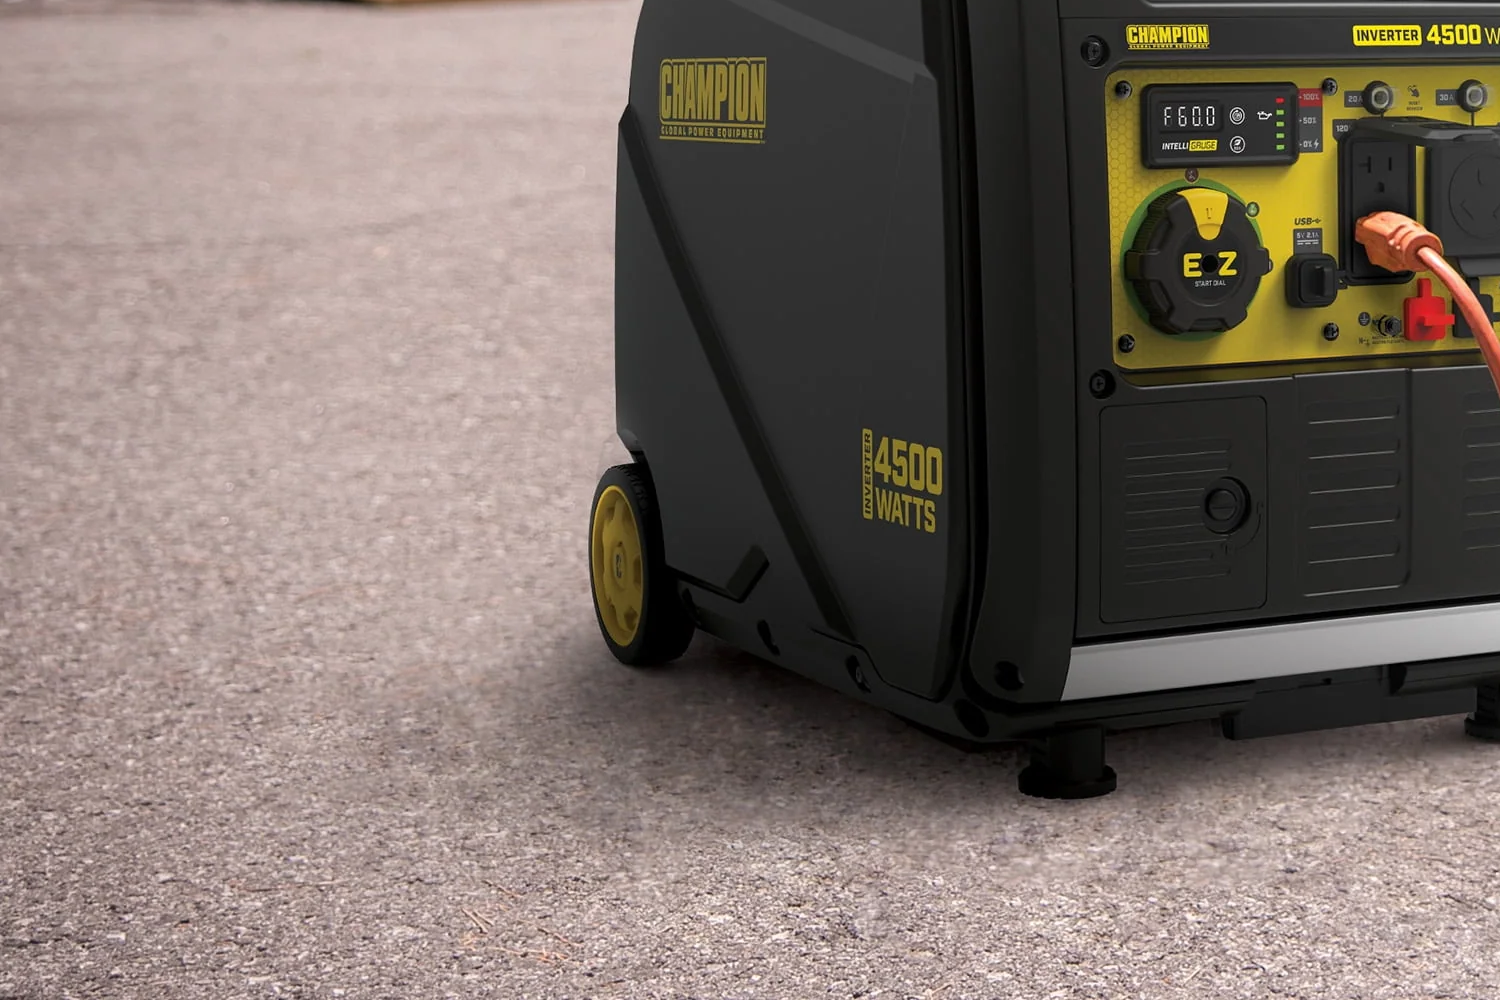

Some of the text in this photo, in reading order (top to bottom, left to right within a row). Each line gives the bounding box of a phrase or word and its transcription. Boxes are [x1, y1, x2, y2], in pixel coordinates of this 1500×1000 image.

[1127, 26, 1208, 43] CHAMPION
[1356, 29, 1419, 42] INVERTER
[1426, 24, 1482, 46] 4500
[661, 63, 764, 121] CHAMPION
[661, 126, 764, 139] GLOBAL POWER EQUIPMENT
[1336, 124, 1350, 132] 120
[1294, 217, 1312, 226] USB
[1194, 280, 1212, 288] START
[864, 432, 872, 515] INVERTER
[874, 436, 943, 496] 4500
[875, 487, 936, 534] WATTS
